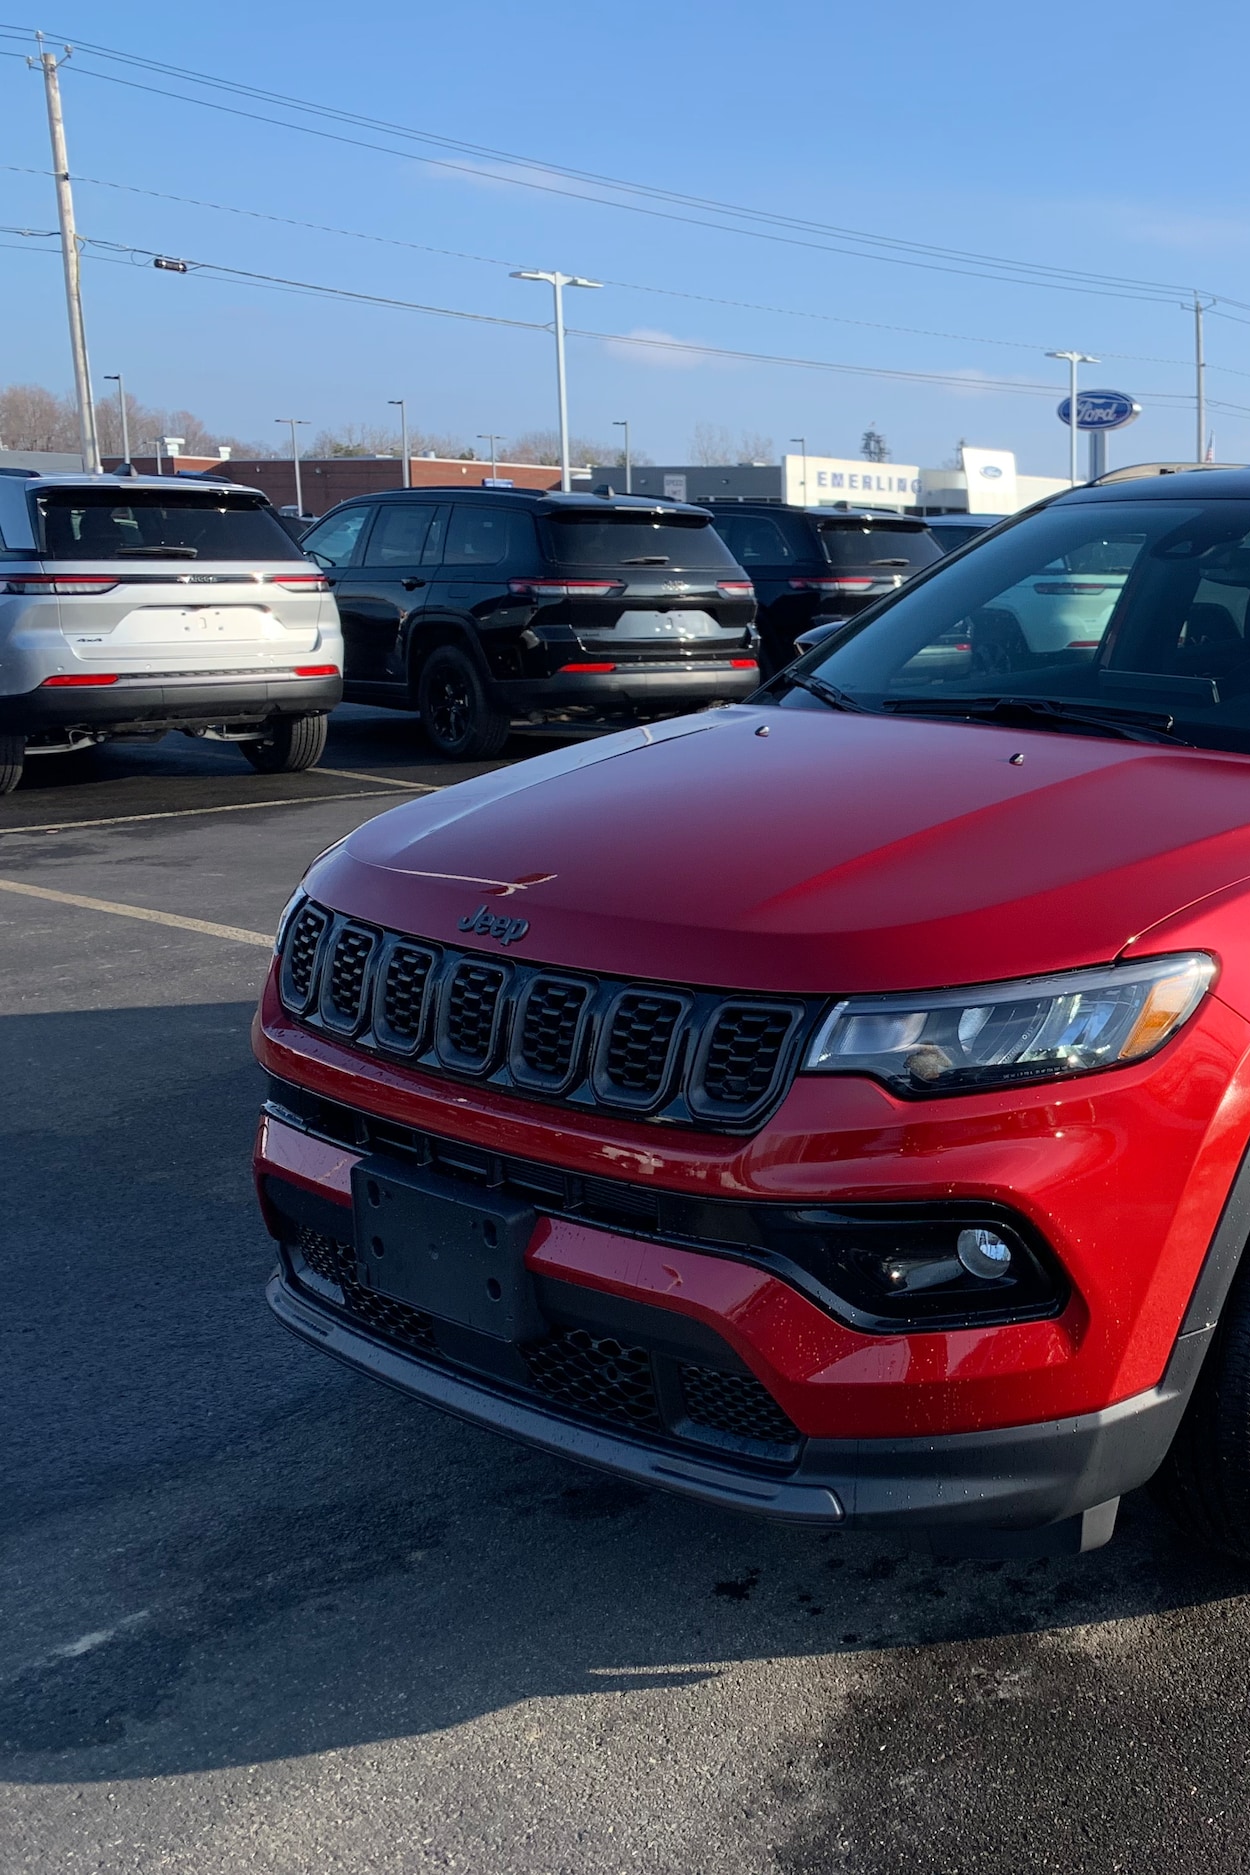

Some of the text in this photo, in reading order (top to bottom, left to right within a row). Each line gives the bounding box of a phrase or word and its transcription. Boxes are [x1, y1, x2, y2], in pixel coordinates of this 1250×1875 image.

[1073, 399, 1118, 421] Ford
[817, 471, 923, 494] EMERLING
[458, 904, 530, 947] Jeep
